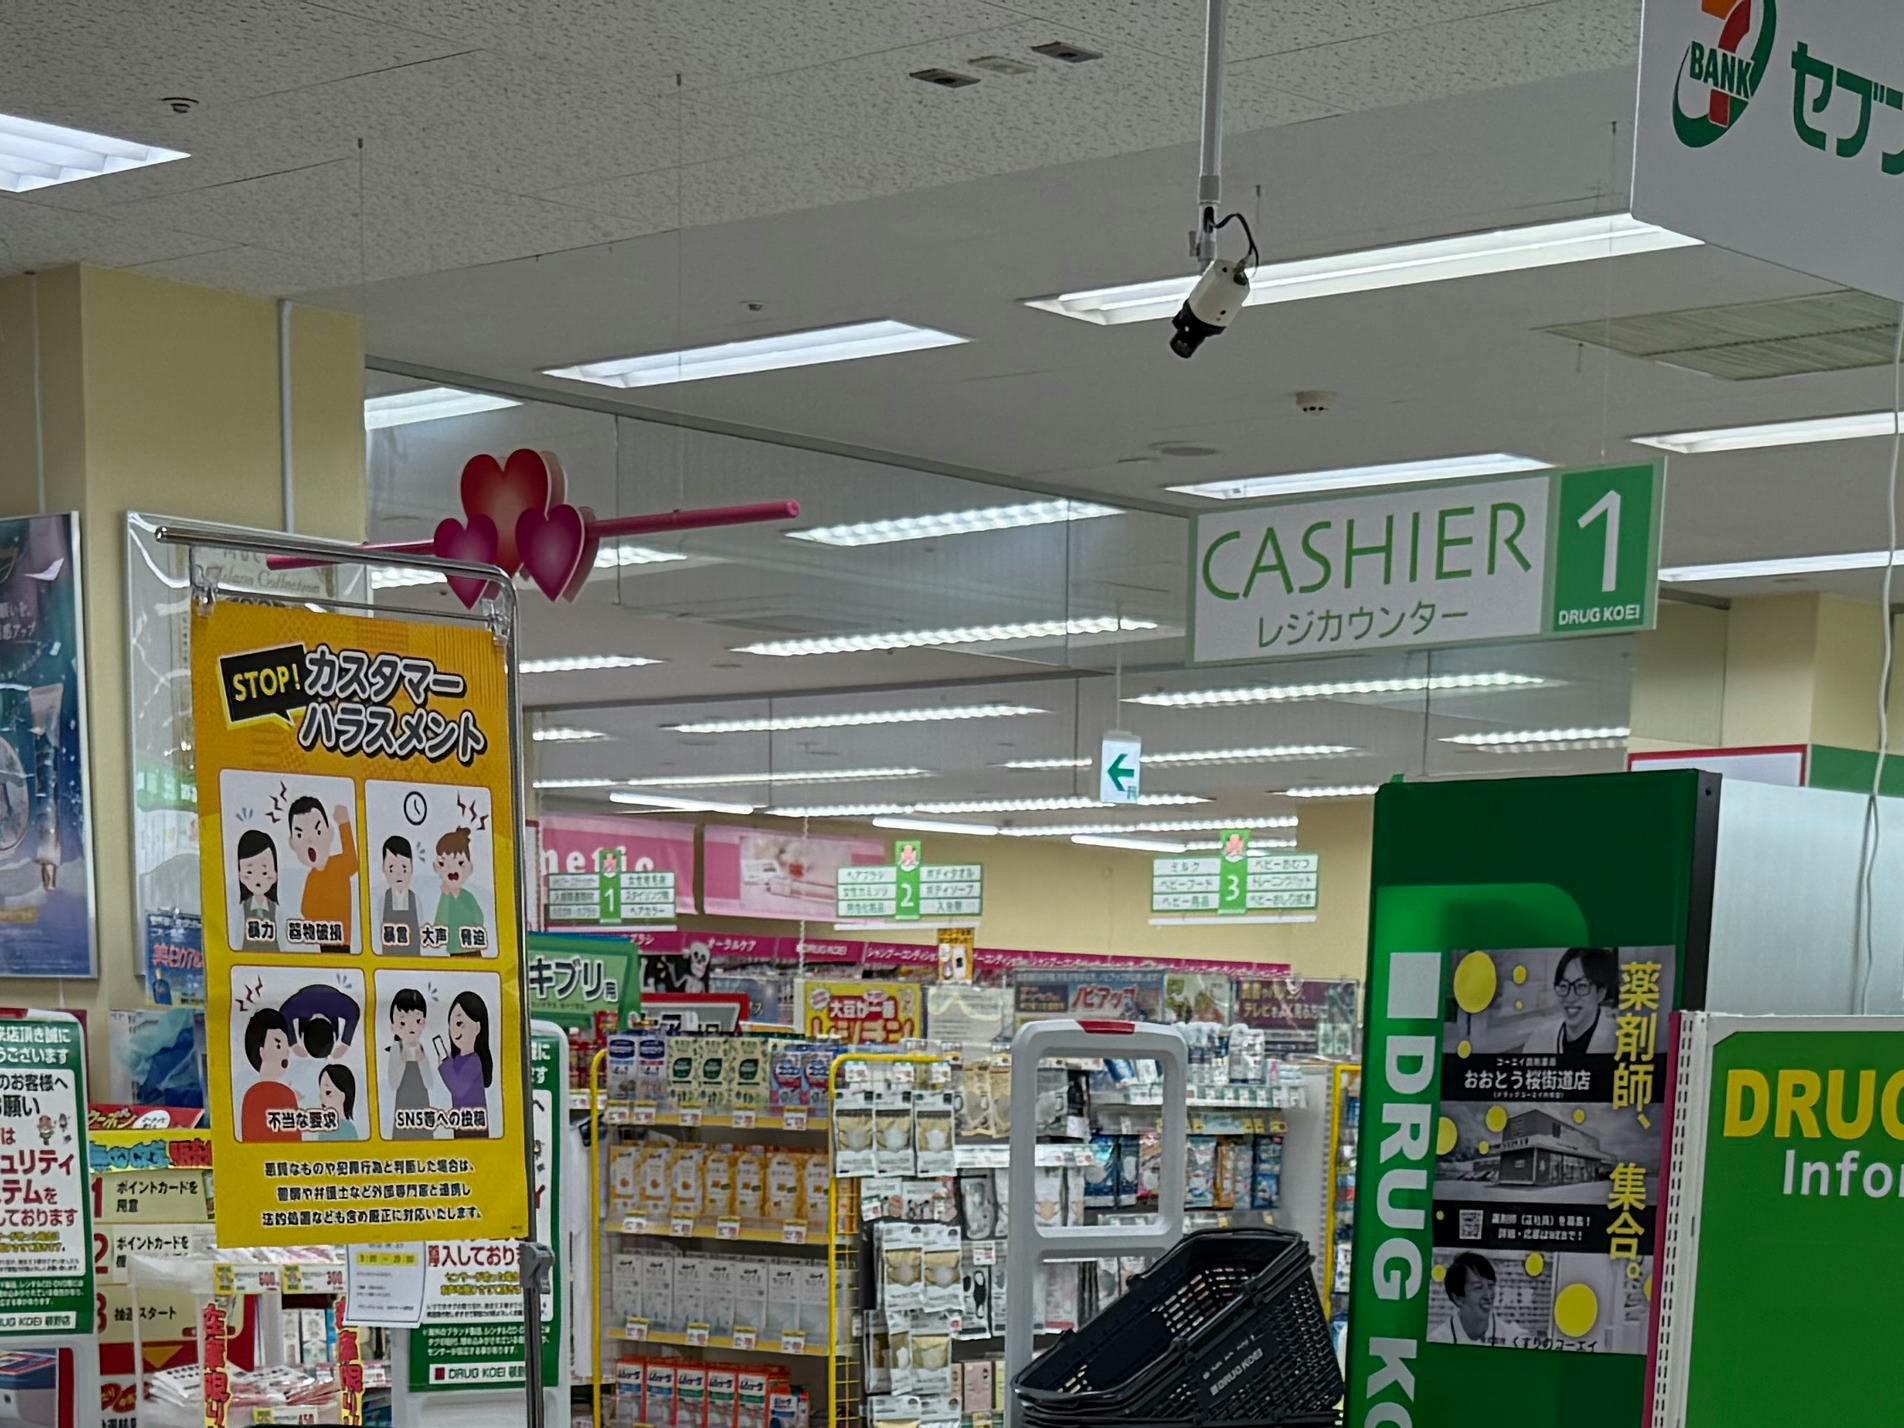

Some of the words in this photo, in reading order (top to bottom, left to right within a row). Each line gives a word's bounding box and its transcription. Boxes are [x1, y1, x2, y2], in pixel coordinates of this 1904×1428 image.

[1688, 41, 1752, 101] BANK
[1202, 501, 1533, 600] CASHIER
[1577, 489, 1622, 593] 1
[1258, 599, 1469, 648] レジカウンター
[1558, 606, 1601, 626] DRUG
[1603, 603, 1641, 623] KOEI
[231, 663, 301, 702] STOP!
[304, 643, 468, 703] カスタマー
[299, 701, 488, 766] ハラスメント
[604, 887, 614, 913] 1
[900, 883, 914, 908] 2
[1225, 874, 1240, 901] 3
[247, 920, 275, 941] 暴力
[288, 923, 344, 942] 器物破損
[383, 926, 409, 945] 暴言
[421, 926, 448, 945] 大声
[1609, 961, 1664, 1131] 薬剤師、
[1463, 1069, 1592, 1091] おおとう桜街道店
[267, 1110, 339, 1129] 不当な要求
[1372, 1034, 1437, 1302] DRUG
[116, 1179, 198, 1196] ポイントカードを
[1605, 1162, 1648, 1281] 集合。
[116, 1235, 190, 1251] ポイントカードを
[448, 1367, 479, 1380] DRUG
